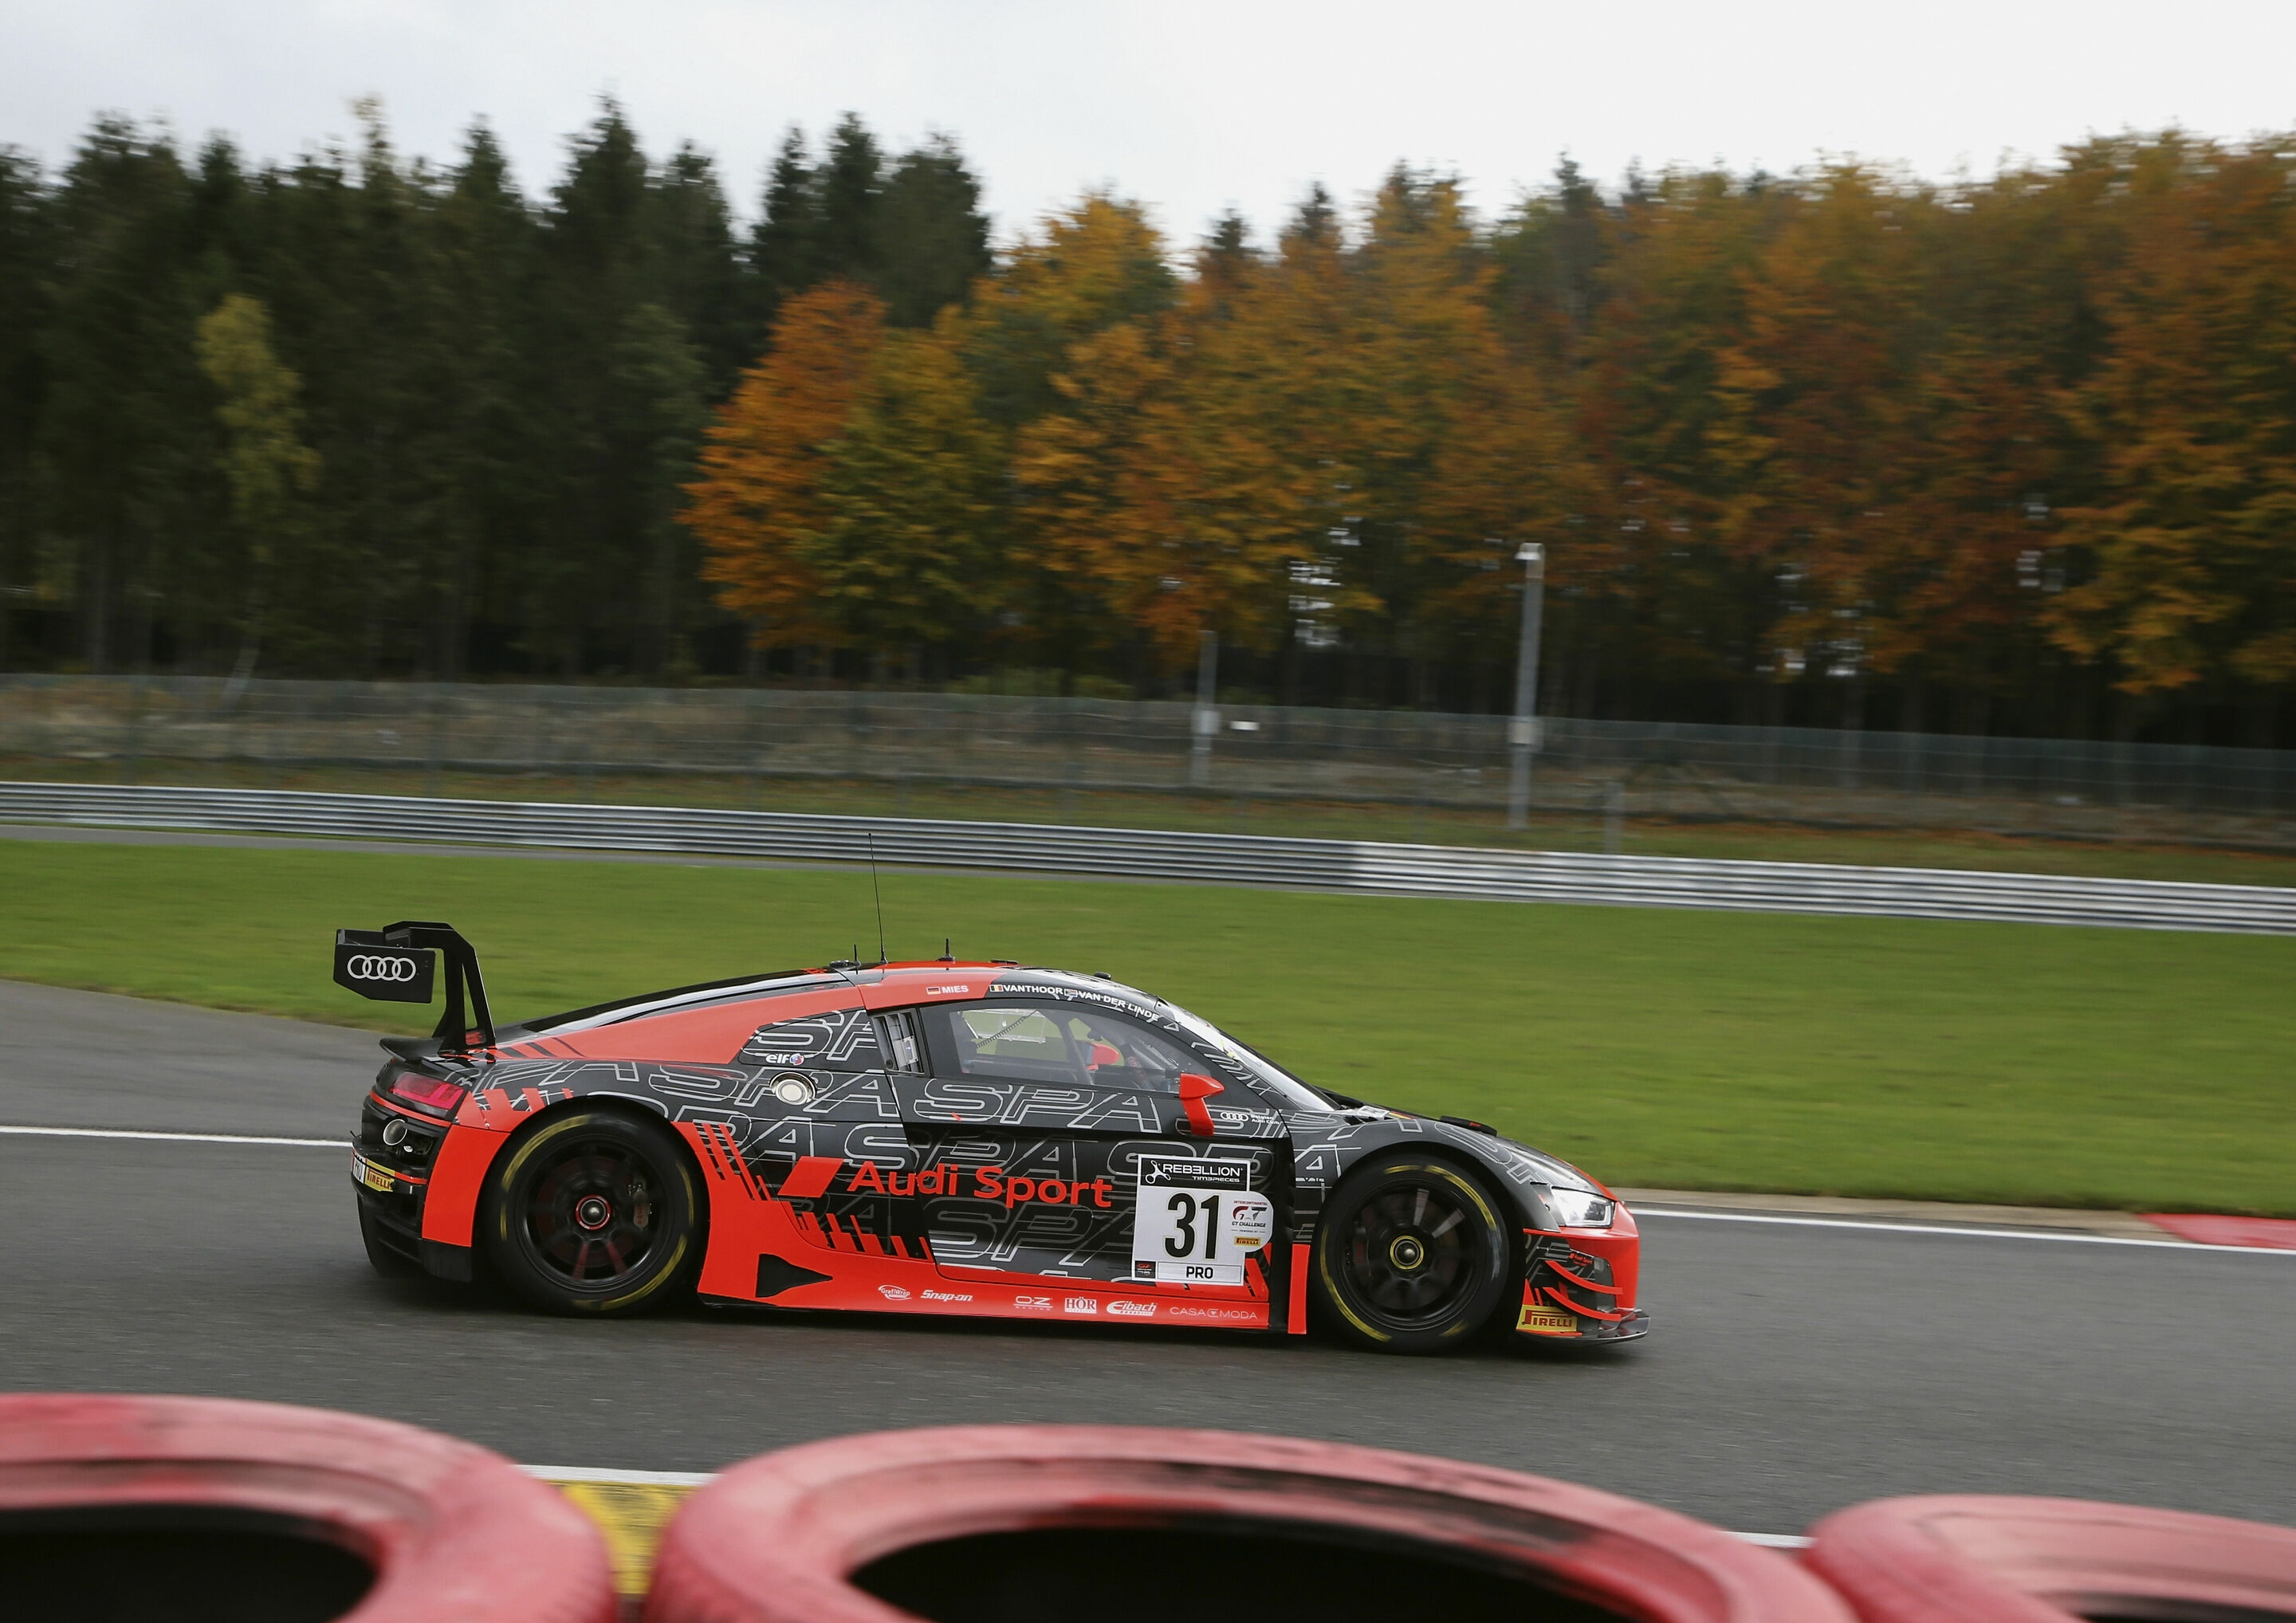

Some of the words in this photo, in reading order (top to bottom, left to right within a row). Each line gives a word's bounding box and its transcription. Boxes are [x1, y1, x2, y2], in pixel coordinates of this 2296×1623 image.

[942, 985, 969, 994] MIES
[1004, 984, 1064, 995] VANTHOOR
[1078, 990, 1101, 1001] VAN
[1103, 996, 1126, 1008] DER
[1127, 1002, 1159, 1022] LINDE
[765, 1053, 790, 1064] elf
[914, 1078, 1162, 1134] SPA
[1162, 1163, 1241, 1177] REBELLION
[847, 1161, 958, 1196] Audi
[973, 1166, 1113, 1208] Sport
[1165, 1193, 1220, 1259] 31
[1185, 1266, 1213, 1279] PRO
[921, 1289, 973, 1302] Snap-on
[1066, 1296, 1095, 1310] HÖR
[1107, 1300, 1158, 1315] Eibach
[1524, 1310, 1574, 1327] PIRELLI
